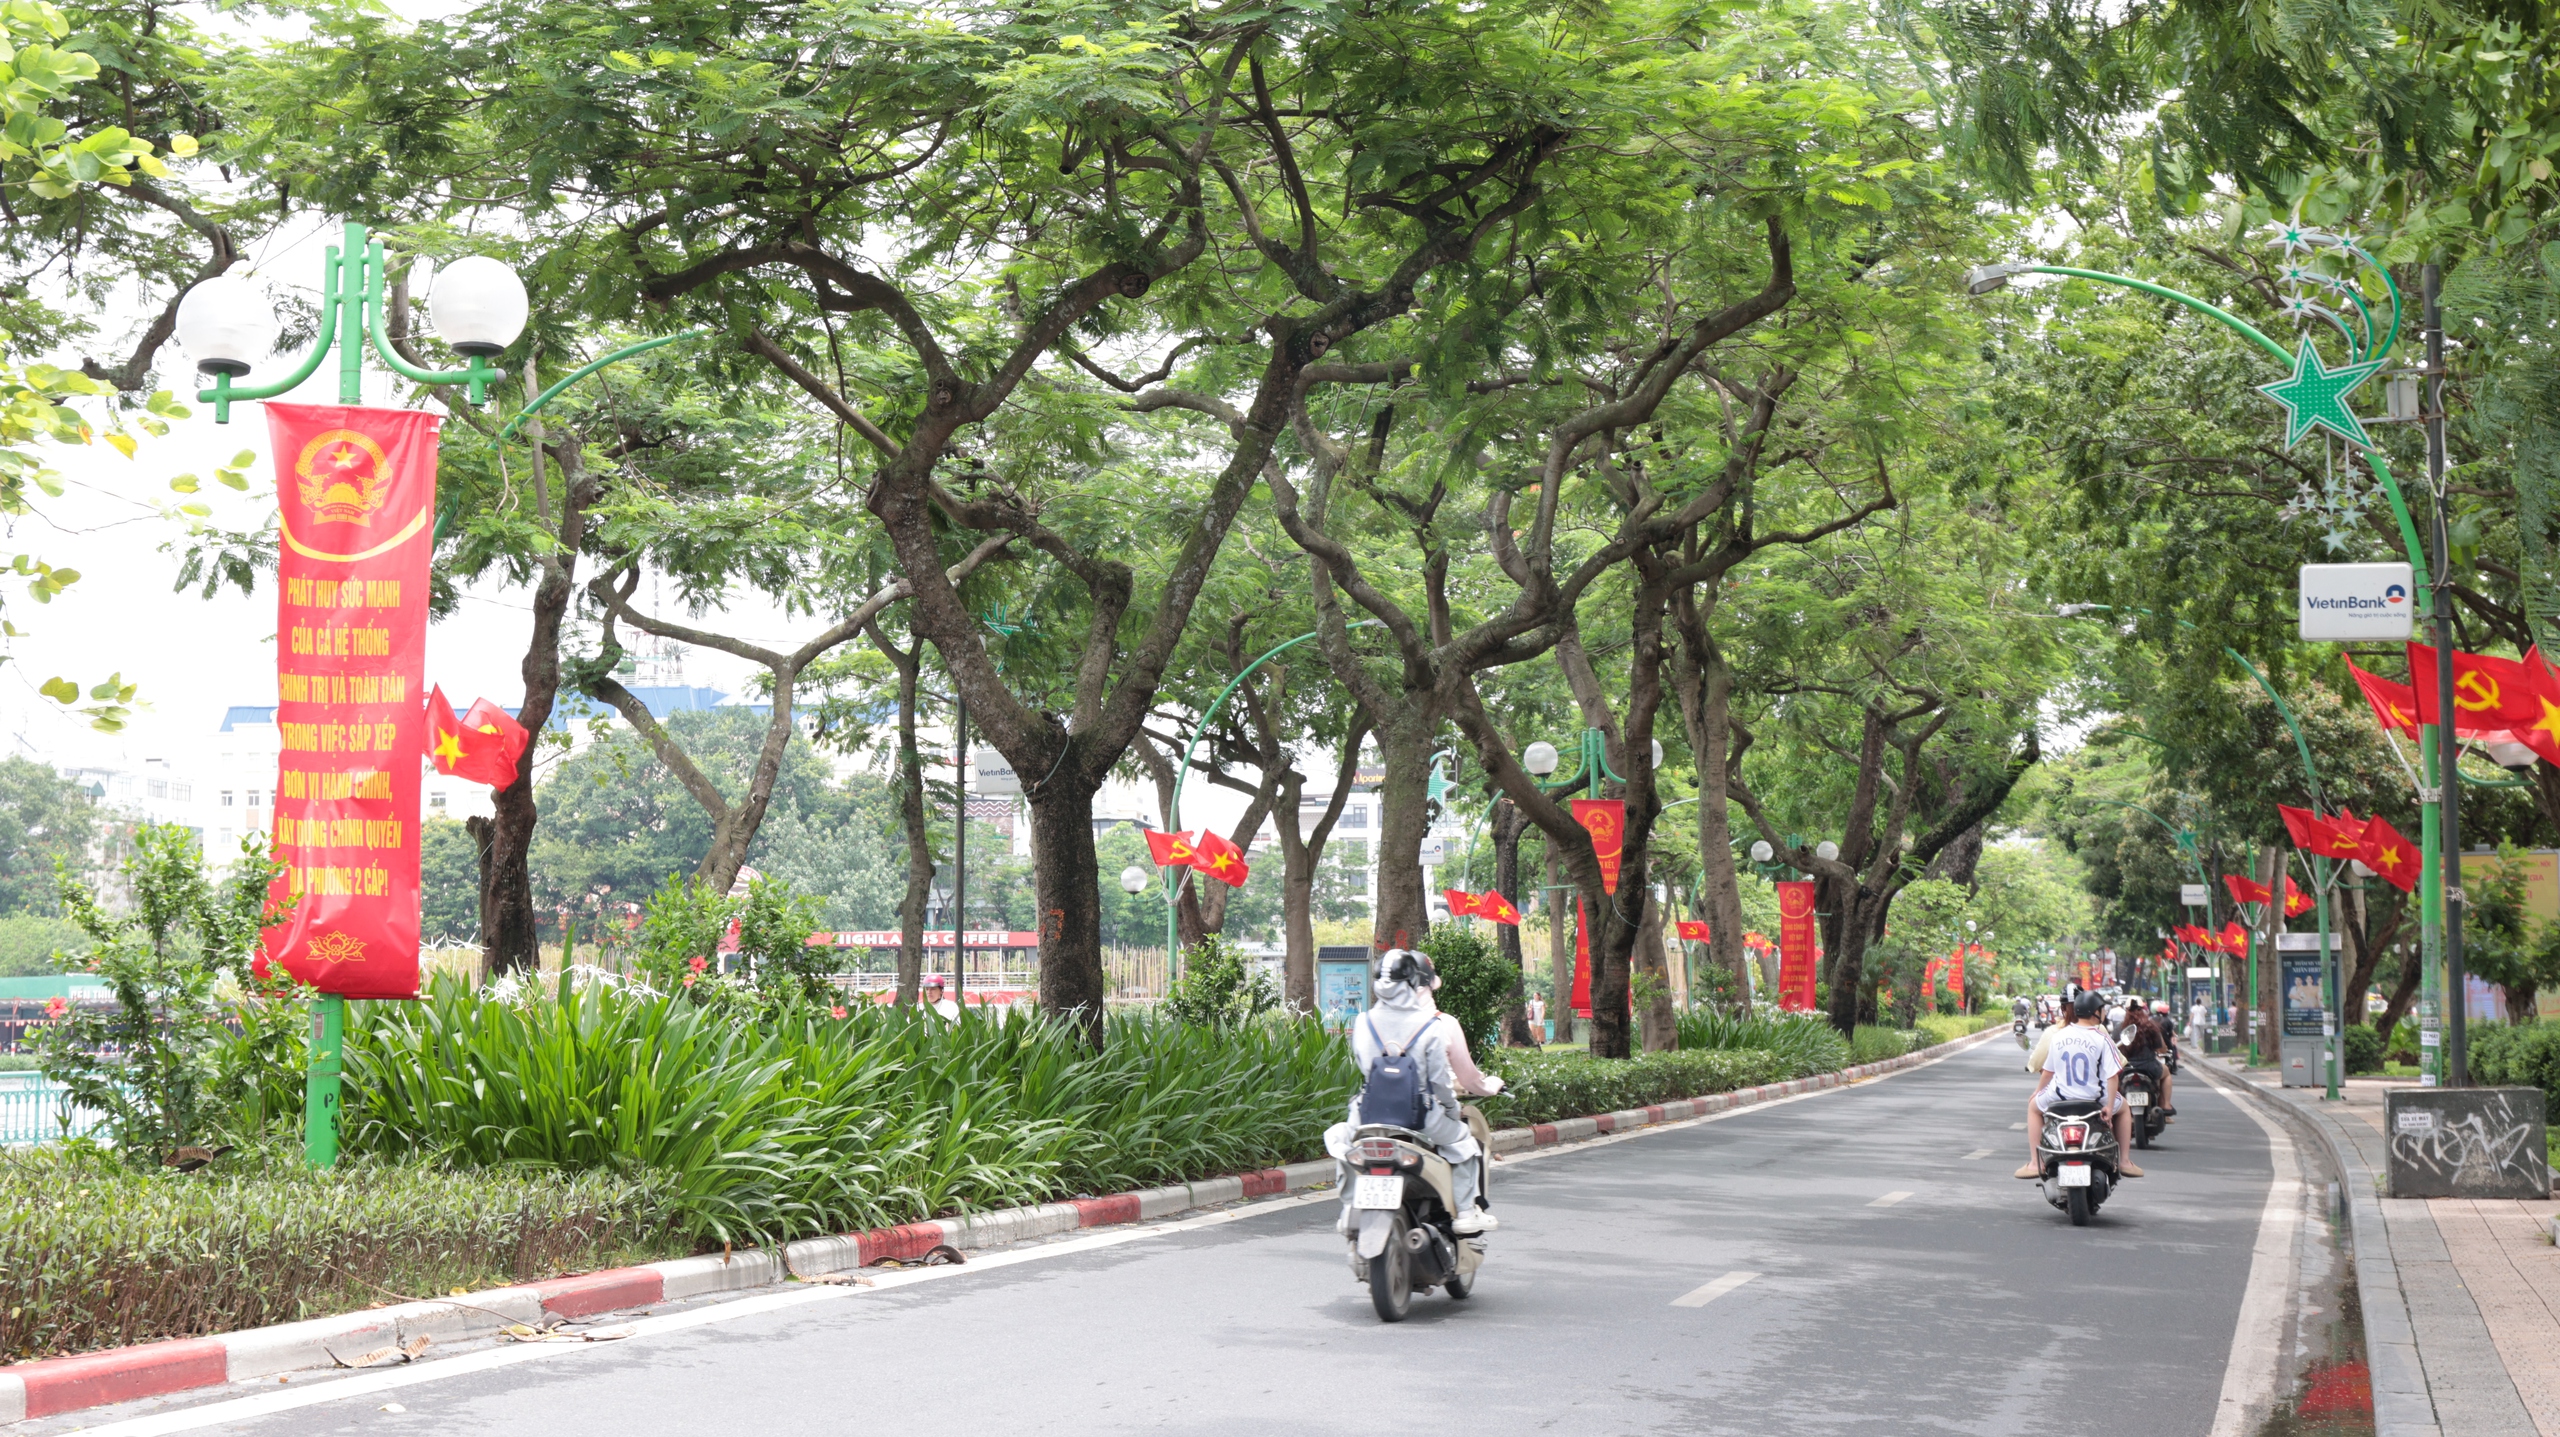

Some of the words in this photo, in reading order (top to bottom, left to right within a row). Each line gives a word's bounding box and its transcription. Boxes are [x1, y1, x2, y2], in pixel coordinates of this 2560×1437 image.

[287, 573, 314, 607] PHÁT
[316, 579, 339, 608] HUY
[341, 574, 364, 608] SỨC
[366, 579, 401, 614] MẠNH
[2306, 595, 2387, 609] VietinBank
[291, 618, 314, 655] CỦA
[316, 619, 332, 656] CẢ
[334, 622, 350, 662] HỆ
[352, 618, 390, 656] THỐNG
[279, 668, 308, 703] CHÍNH
[311, 675, 329, 710] TRỊ
[331, 670, 346, 703] VÀ
[349, 670, 379, 704] TOÀN
[382, 670, 405, 703] DÂN
[282, 721, 318, 751] TRONG
[320, 718, 346, 758] VIỆC
[349, 714, 371, 752] SẮP
[374, 714, 396, 751] XẾP
[284, 768, 306, 799] ĐƠN
[308, 771, 319, 806] VỊ
[322, 767, 353, 801] HÀNH
[355, 765, 393, 802] CHÍNH,
[978, 768, 1017, 777] VietinBan
[278, 812, 295, 845] XÂY
[296, 816, 327, 853] DỰNG
[330, 813, 363, 847] CHÍNH
[365, 811, 402, 850] QUYỀN
[306, 866, 353, 895] PHƯƠNG
[355, 867, 362, 895] 2
[364, 858, 389, 896] CẤP!
[833, 933, 939, 946] HIGHLADS
[944, 933, 1010, 946] CFFEE
[2056, 1037, 2098, 1054] ZIDANE
[2061, 1050, 2090, 1086] 10
